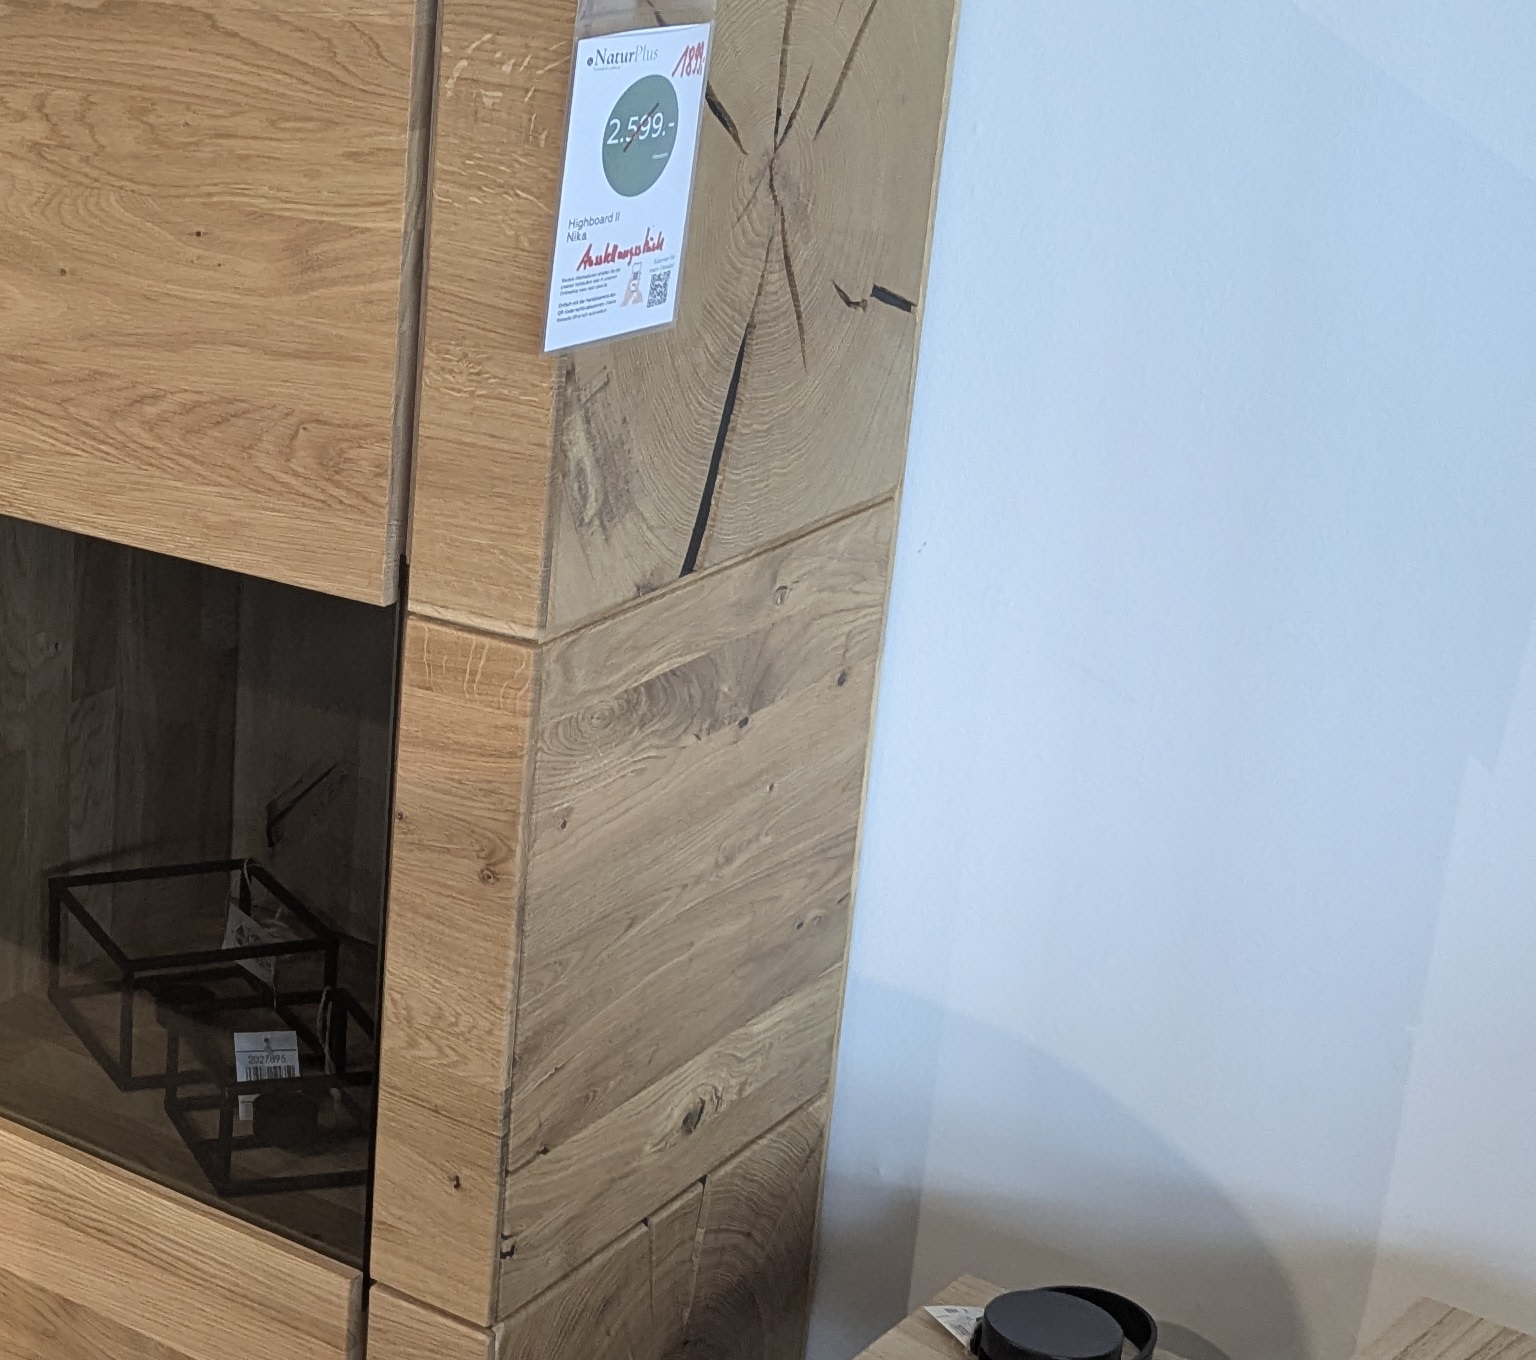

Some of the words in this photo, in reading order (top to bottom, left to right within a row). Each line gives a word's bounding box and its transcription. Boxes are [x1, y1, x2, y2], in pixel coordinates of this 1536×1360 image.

[594, 44, 659, 66] NaturPlus
[606, 112, 675, 145] 2.599.-
[567, 211, 614, 231] Highboard
[566, 231, 587, 242] Nika
